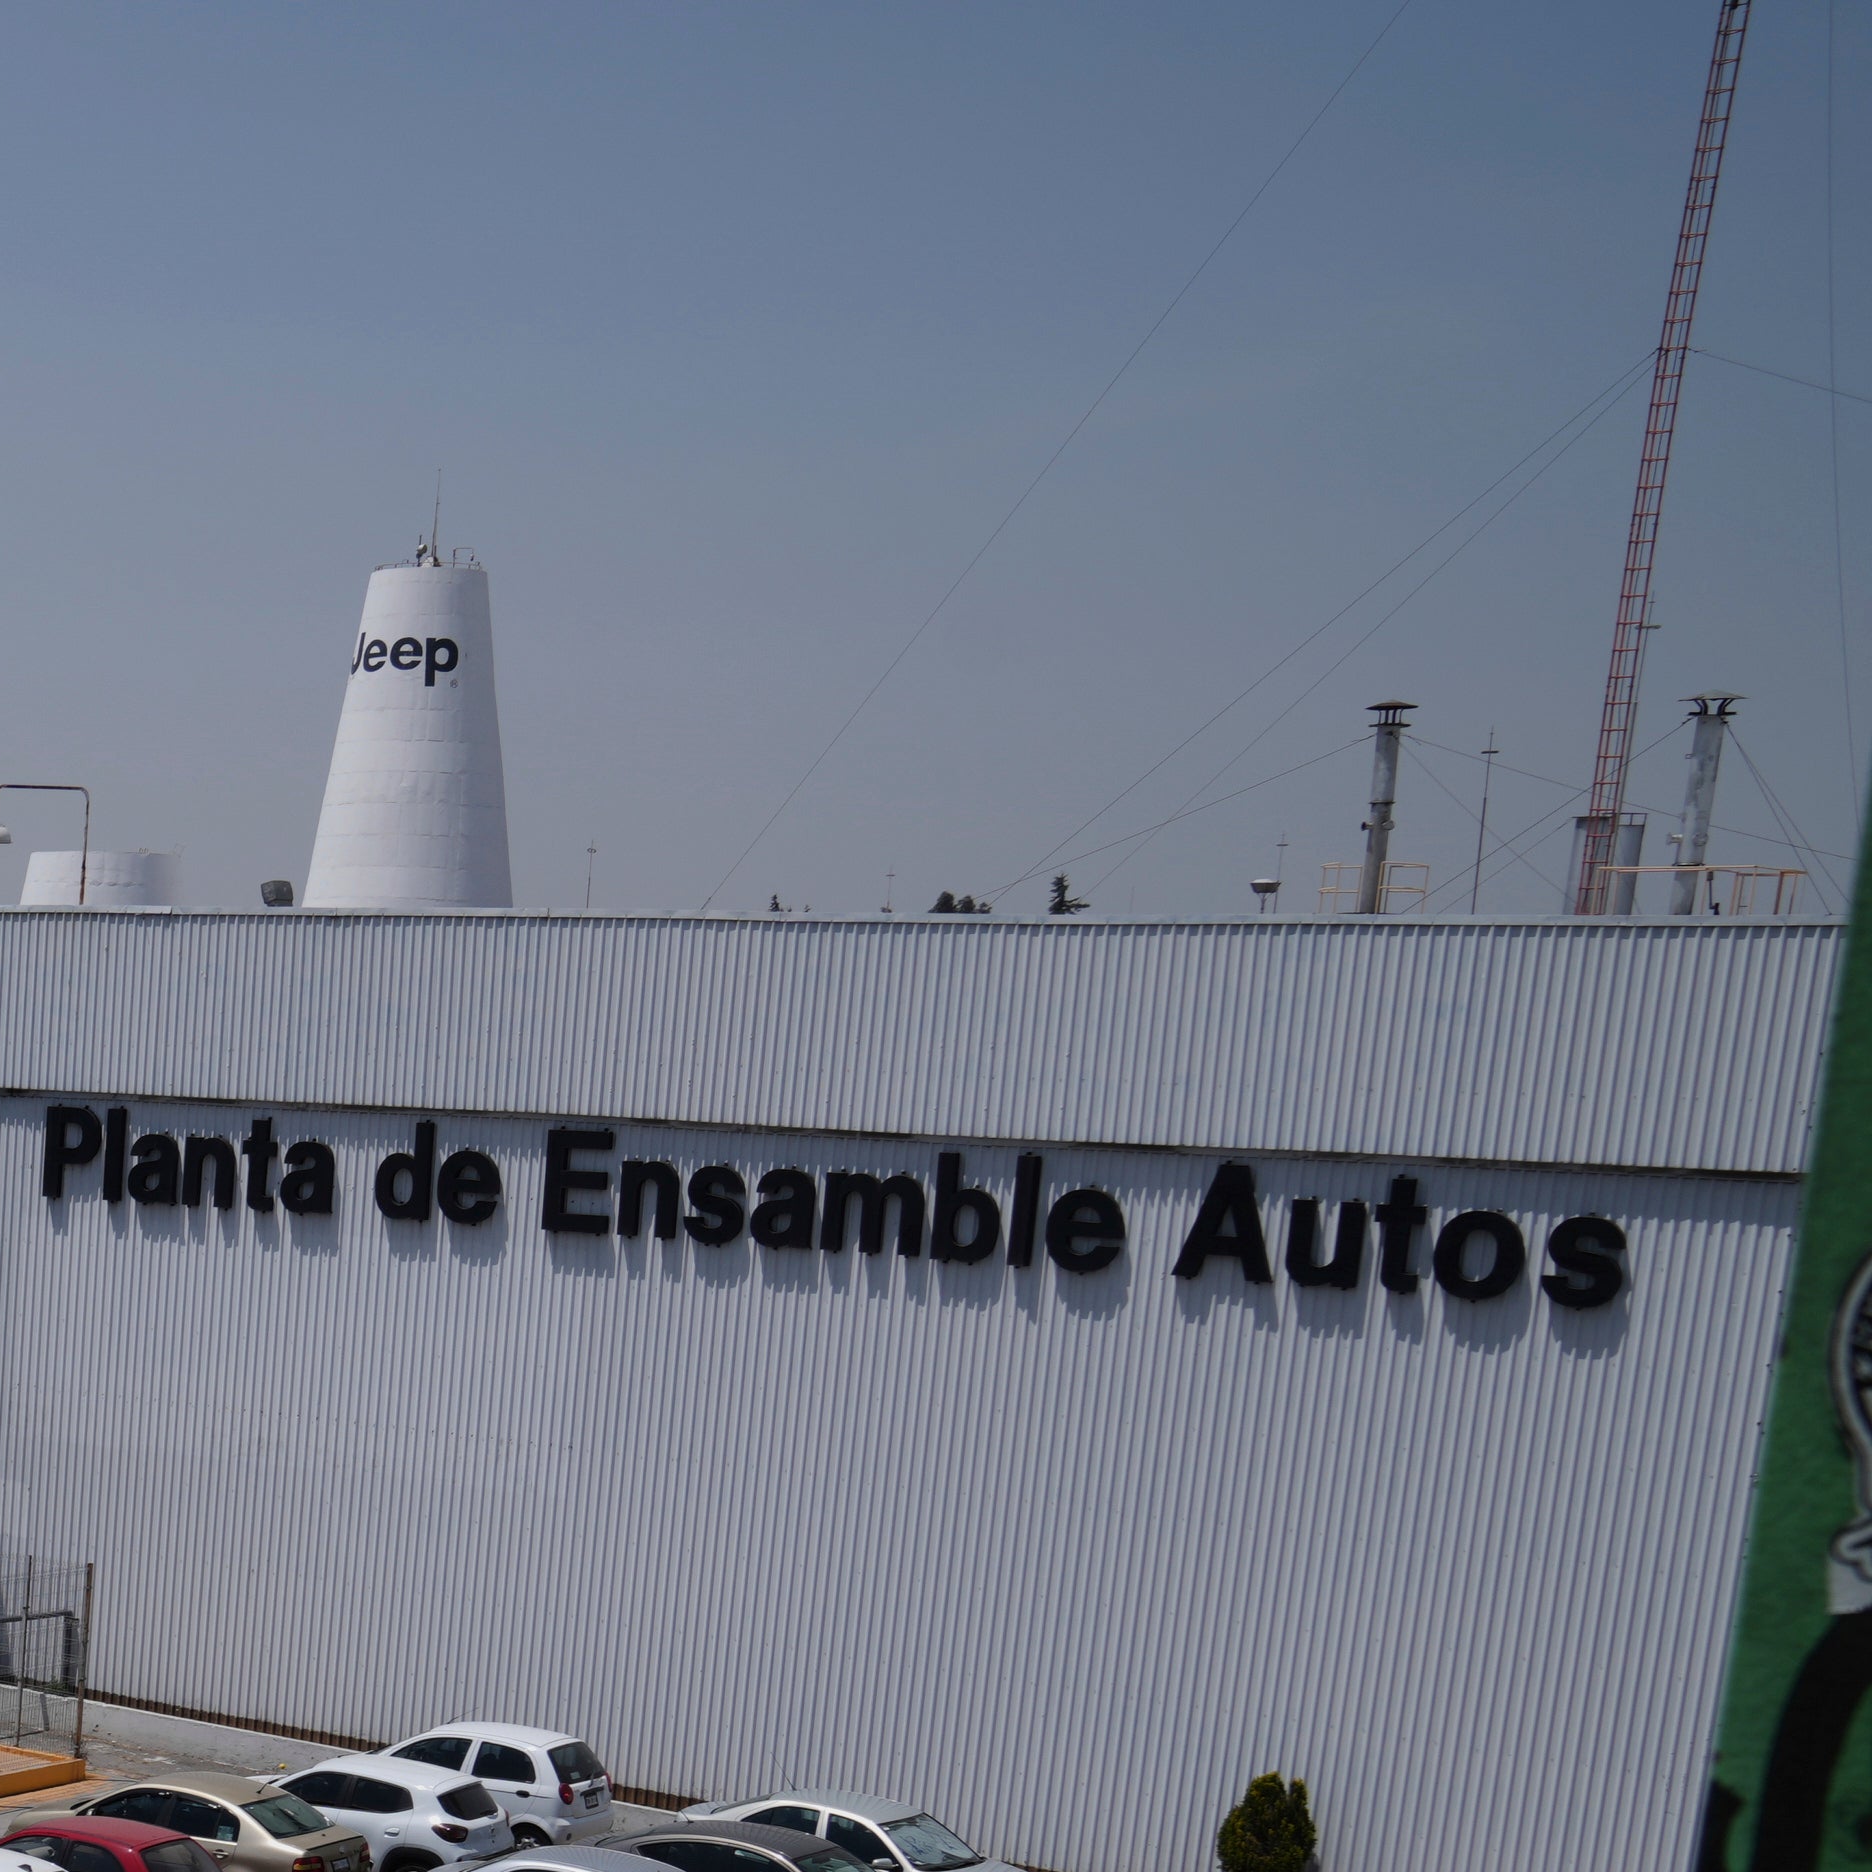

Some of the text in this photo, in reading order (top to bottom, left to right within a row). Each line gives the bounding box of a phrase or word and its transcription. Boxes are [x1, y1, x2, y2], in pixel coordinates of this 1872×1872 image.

[351, 632, 459, 687] Jeep
[42, 1101, 1628, 1314] Planta de Ensamble Autos
